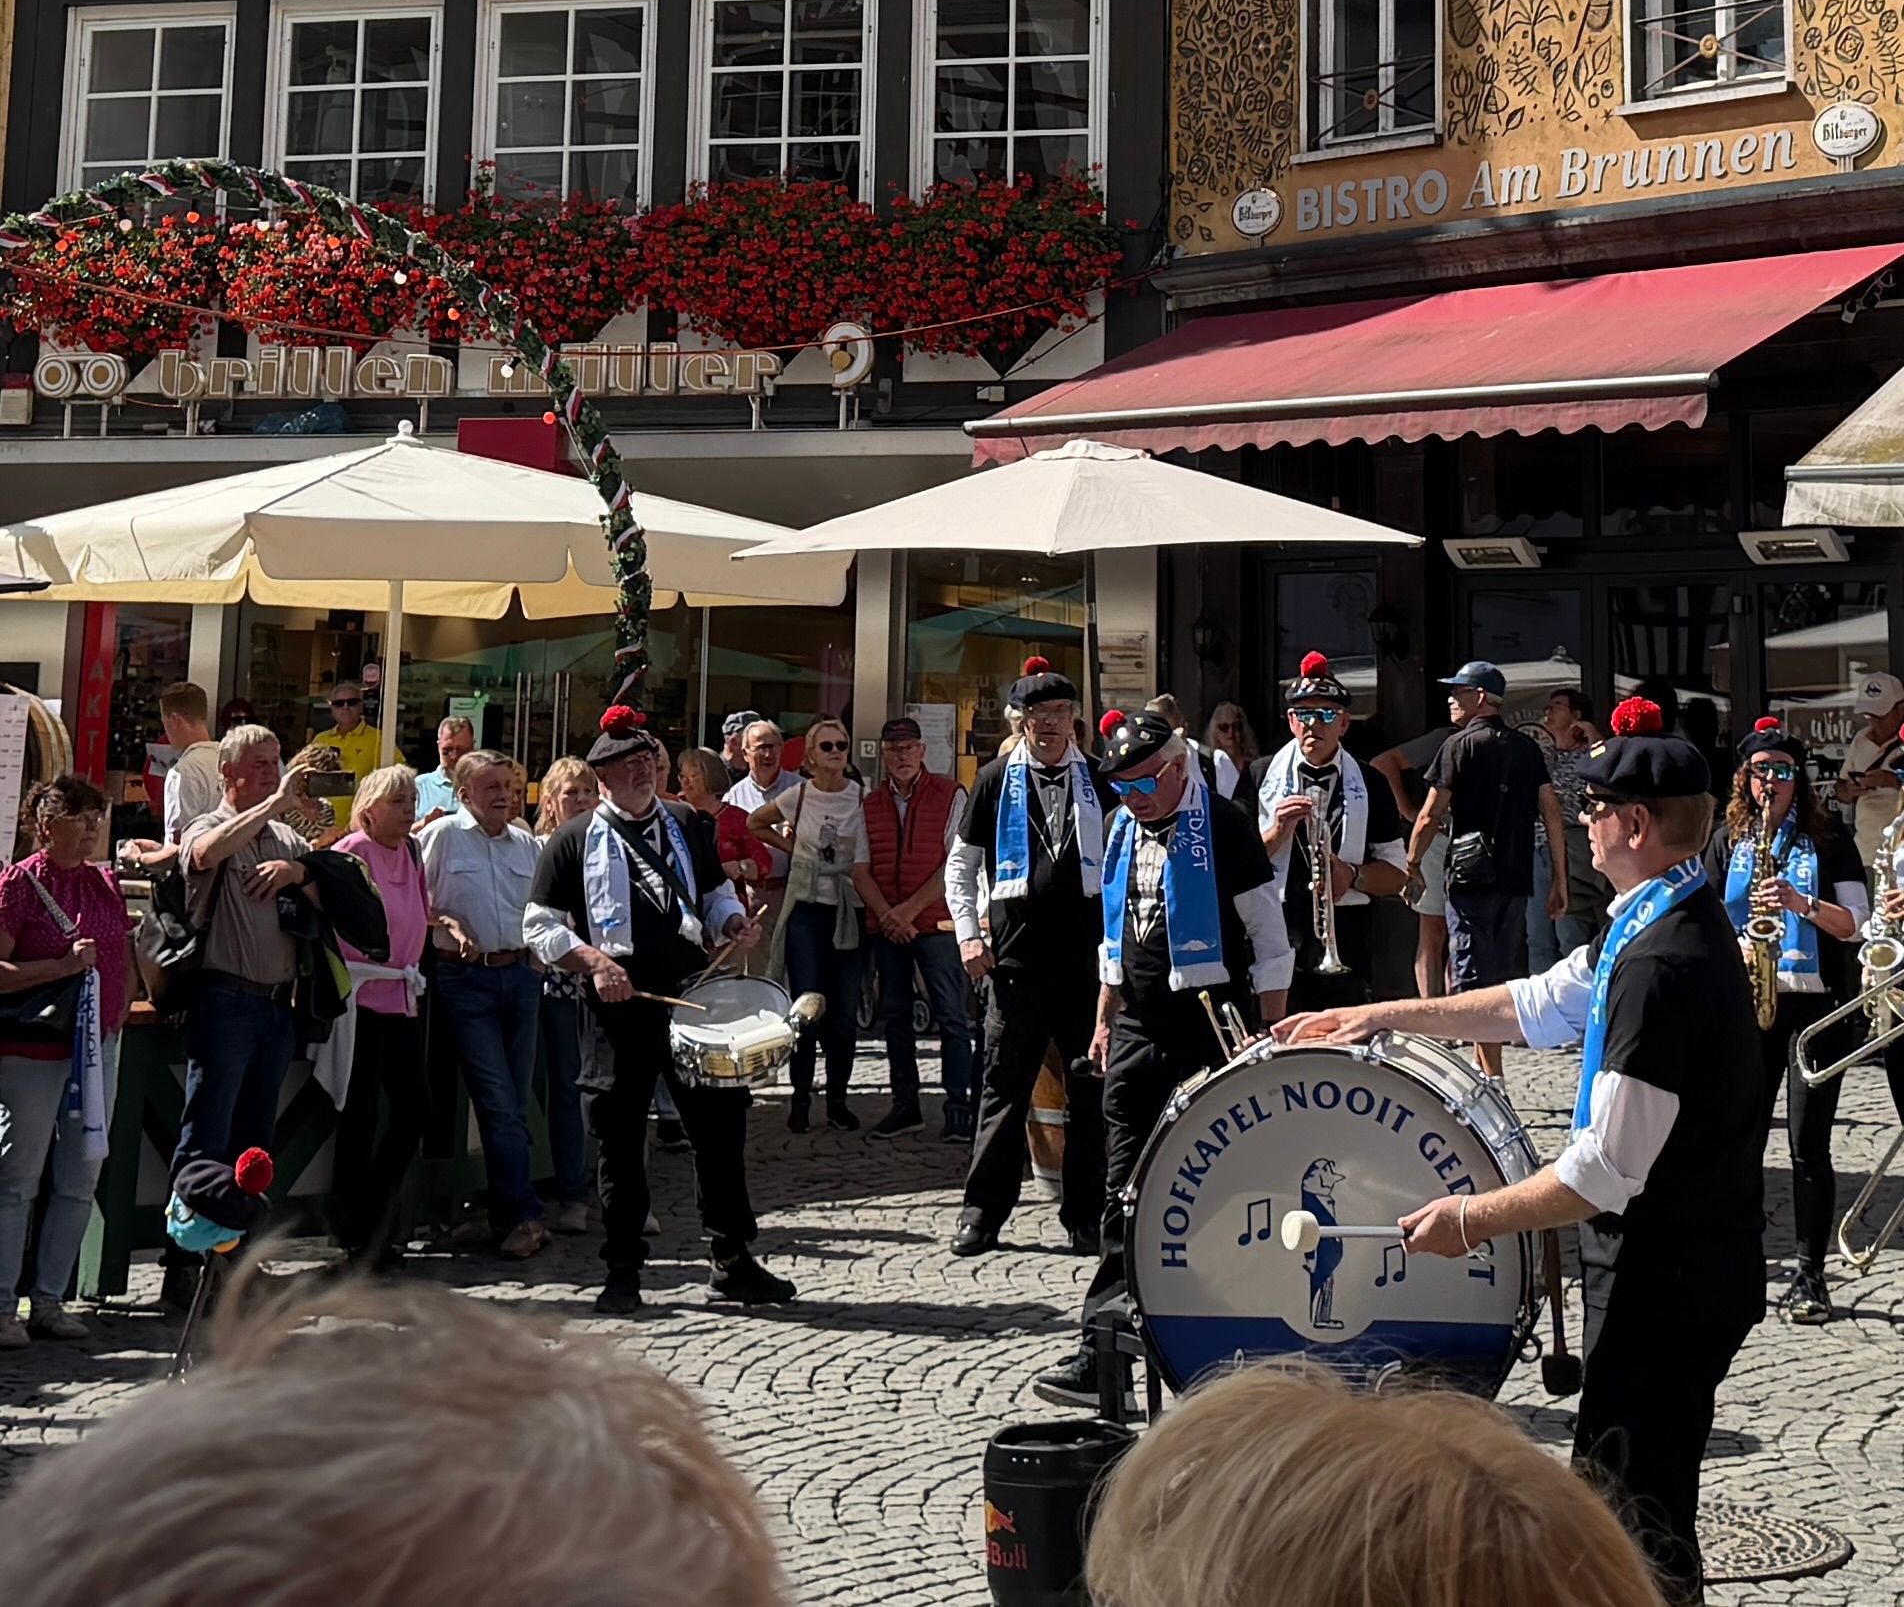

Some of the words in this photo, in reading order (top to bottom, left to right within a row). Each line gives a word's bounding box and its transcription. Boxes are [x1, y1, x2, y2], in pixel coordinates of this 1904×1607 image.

[1296, 168, 1449, 232] BISTRO
[1461, 159, 1543, 210] Am
[1554, 128, 1799, 201] Brunnen
[157, 345, 456, 398] brillen
[1161, 1090, 1272, 1269] HOFKAPEL
[1281, 1079, 1415, 1132] NOOIT
[1418, 1131, 1496, 1287] GEDT
